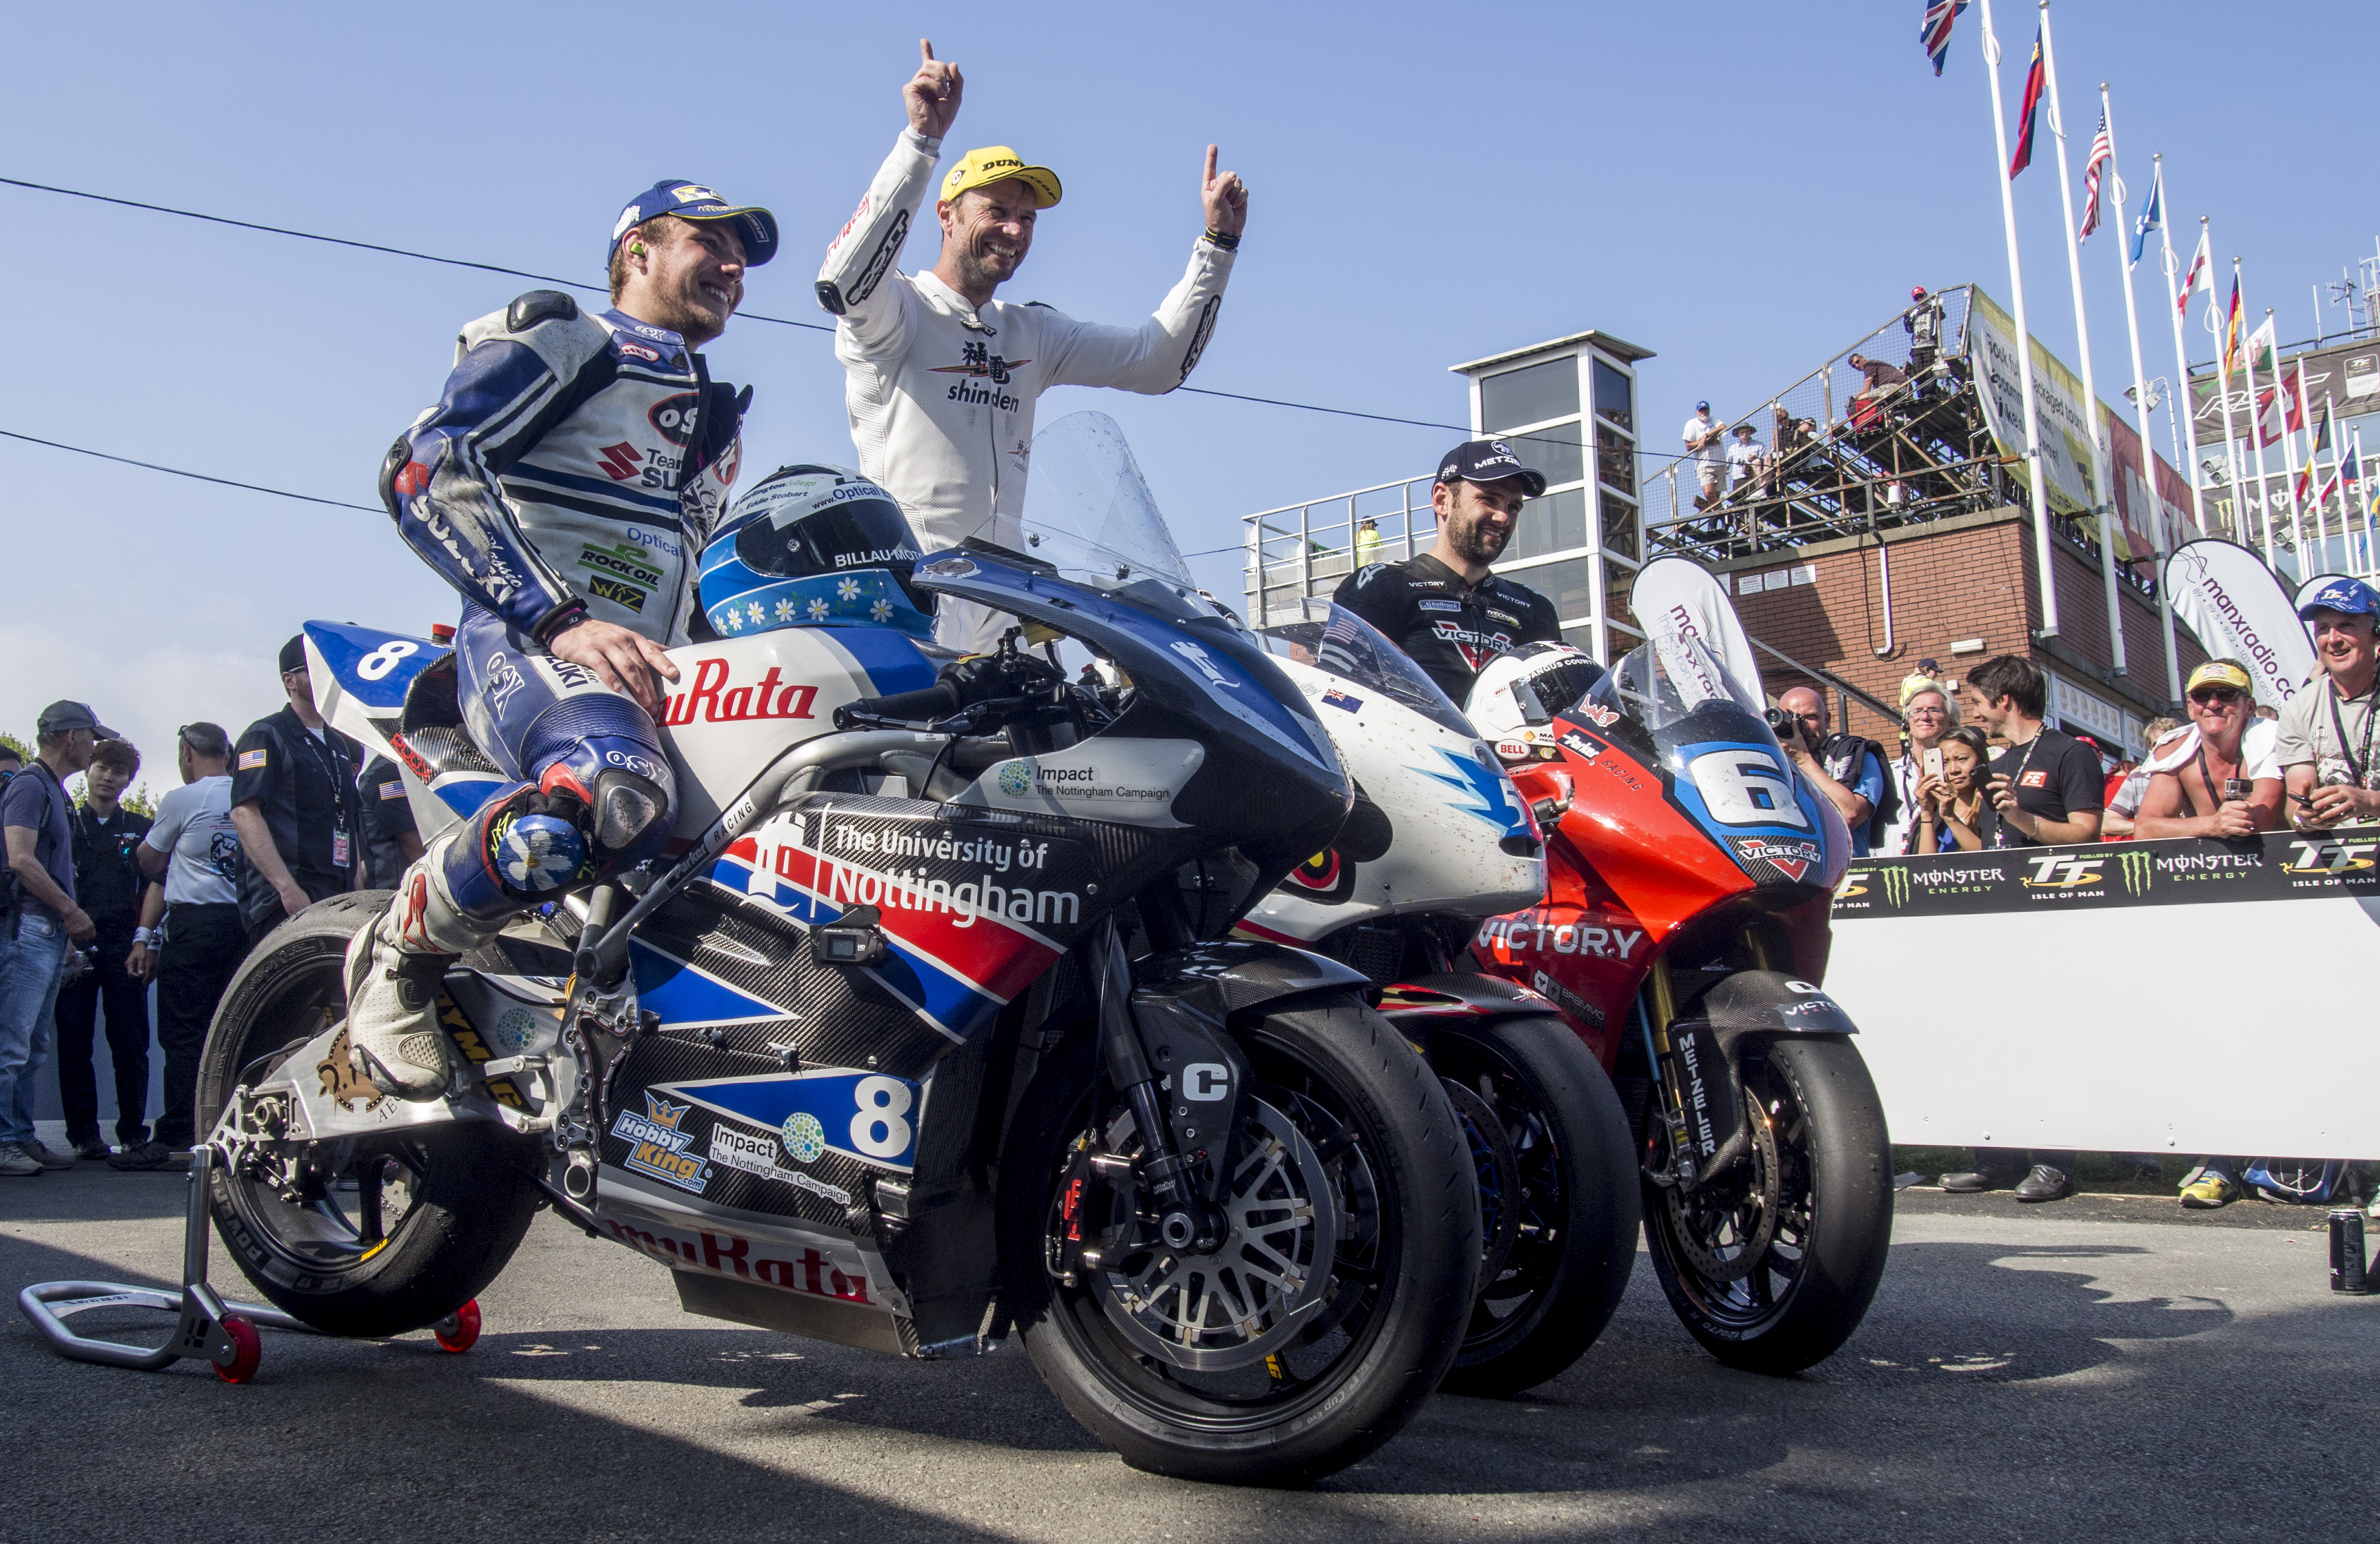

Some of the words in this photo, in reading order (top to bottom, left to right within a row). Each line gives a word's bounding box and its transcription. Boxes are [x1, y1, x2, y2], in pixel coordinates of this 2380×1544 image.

[983, 159, 1025, 171] DUN
[947, 379, 1019, 413] shinden
[2032, 375, 2064, 417] ackaged
[746, 497, 769, 509] Eddie
[770, 492, 808, 501] Stobart
[627, 528, 683, 557] Optical
[580, 551, 635, 574] ROCK
[634, 569, 659, 586] OIL
[1497, 592, 1531, 608] VICTORY
[357, 641, 418, 680] 8
[1531, 661, 1564, 678] ANGUS
[1495, 686, 1507, 695] BELL
[1501, 744, 1524, 754] BELL
[1563, 734, 1601, 759] Parker
[1036, 765, 1094, 783] Impact
[1601, 760, 1644, 792] RACING
[1689, 749, 1808, 828] 6
[1035, 785, 1053, 795] The
[1056, 785, 1113, 798] Nottingham
[1116, 787, 1170, 800] Campaign
[713, 802, 753, 842] RACING
[673, 843, 707, 880] Parker
[834, 825, 876, 852] The
[881, 829, 1011, 872] University
[1019, 843, 1048, 868] of
[1742, 845, 1821, 863] VICTORY
[1928, 885, 1992, 895] ENERGY
[2174, 871, 2247, 882] ENERGY
[2346, 876, 2376, 885] MAN
[829, 861, 1080, 928] Nottingham
[1477, 920, 1645, 960] VICTORY
[1785, 1000, 1836, 1016] VICTO
[1680, 1033, 1716, 1156] METZELER
[850, 1076, 912, 1158] 8
[619, 1117, 684, 1152] Hobby
[714, 1125, 774, 1159] Impact
[635, 1141, 699, 1179] King
[712, 1147, 728, 1163] The
[731, 1154, 793, 1182] Nottingham
[797, 1174, 849, 1203] Campaign
[680, 1177, 701, 1188] .com
